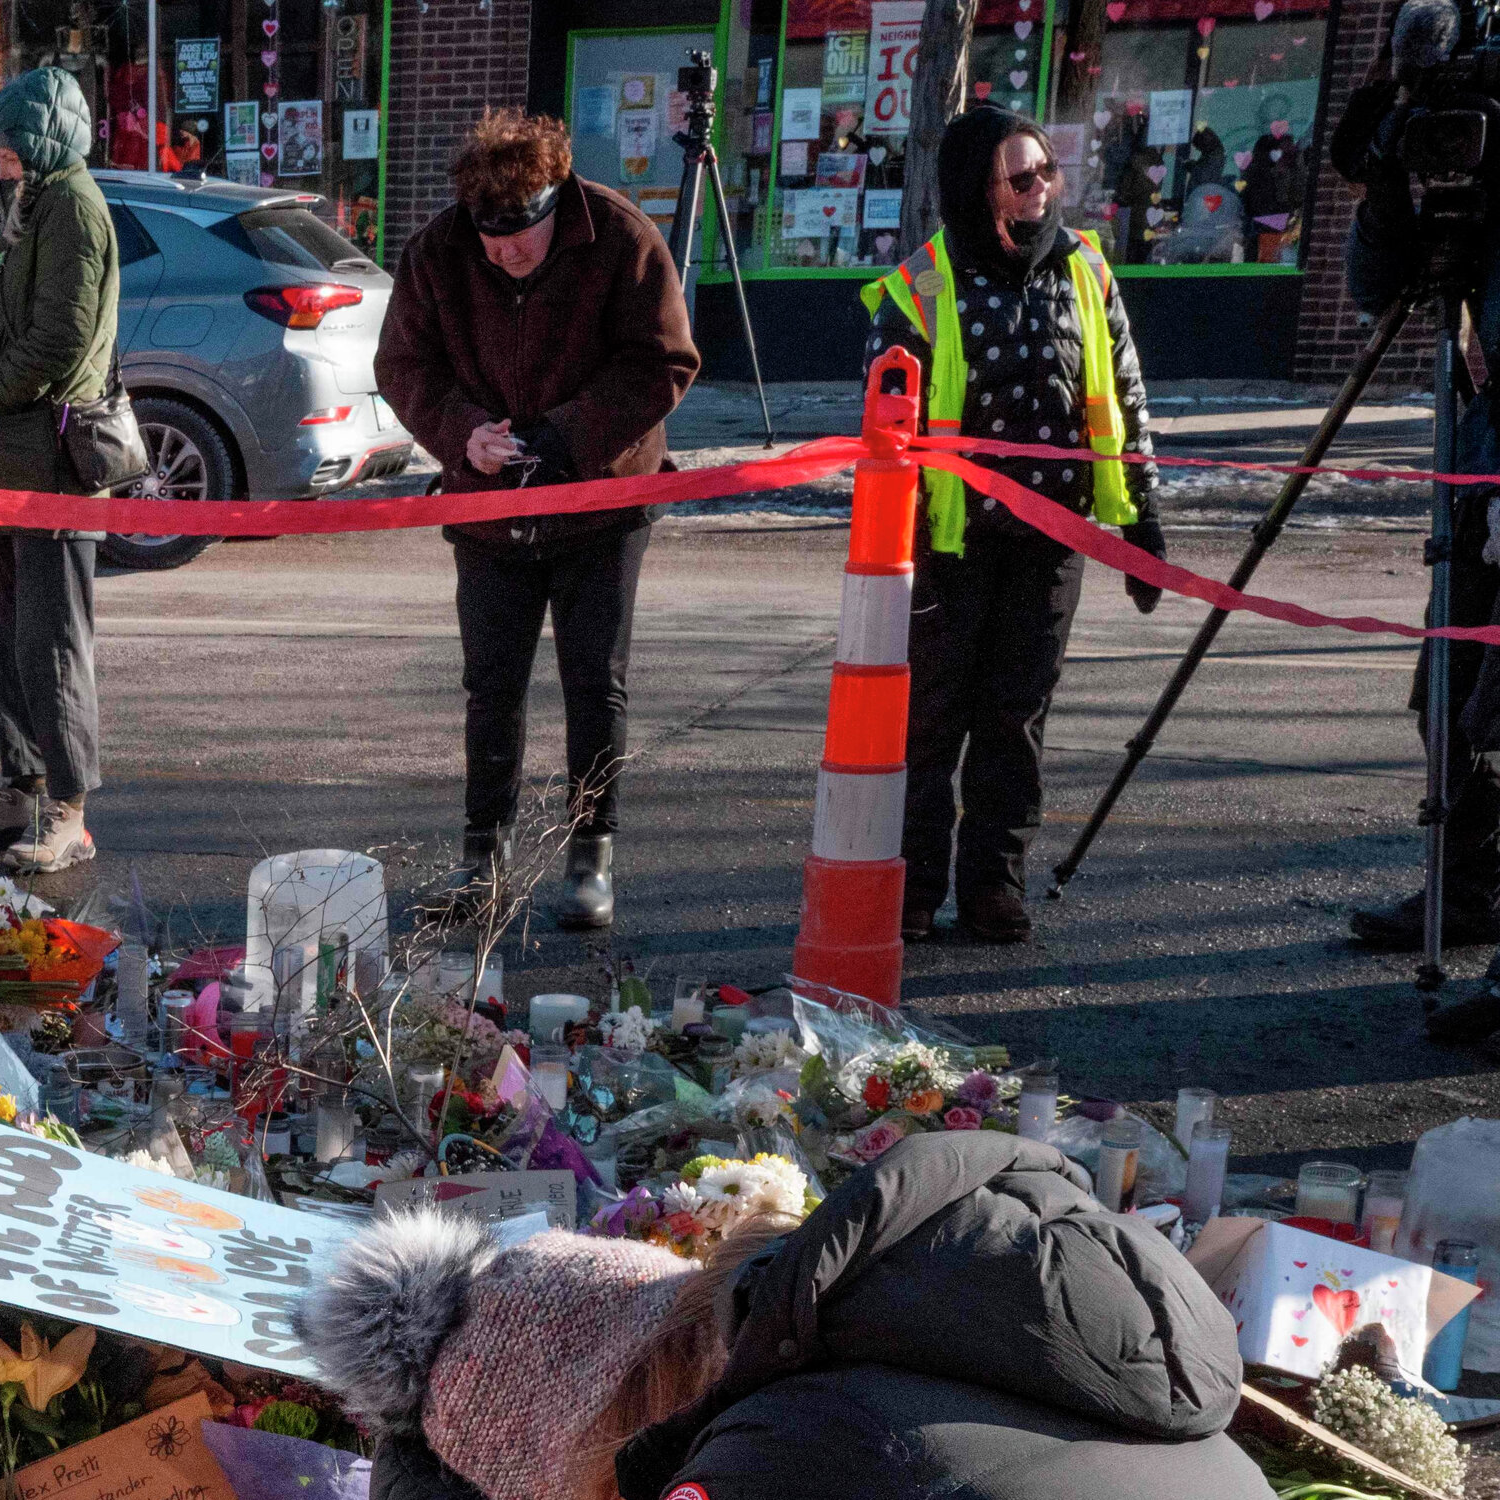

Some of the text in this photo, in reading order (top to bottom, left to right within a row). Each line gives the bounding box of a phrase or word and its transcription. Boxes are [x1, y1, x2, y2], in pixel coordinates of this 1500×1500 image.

[180, 43, 202, 53] DOES
[827, 36, 866, 52] ICE
[880, 29, 920, 41] NEIGHB
[202, 51, 218, 60] YOU
[336, 16, 356, 100] OPEN
[826, 51, 865, 75] OUT!
[877, 45, 920, 82] IC
[874, 87, 911, 122] OU
[218, 1229, 314, 1288] LOVE
[30, 1274, 121, 1315] OF
[53, 1456, 100, 1487] Pretti
